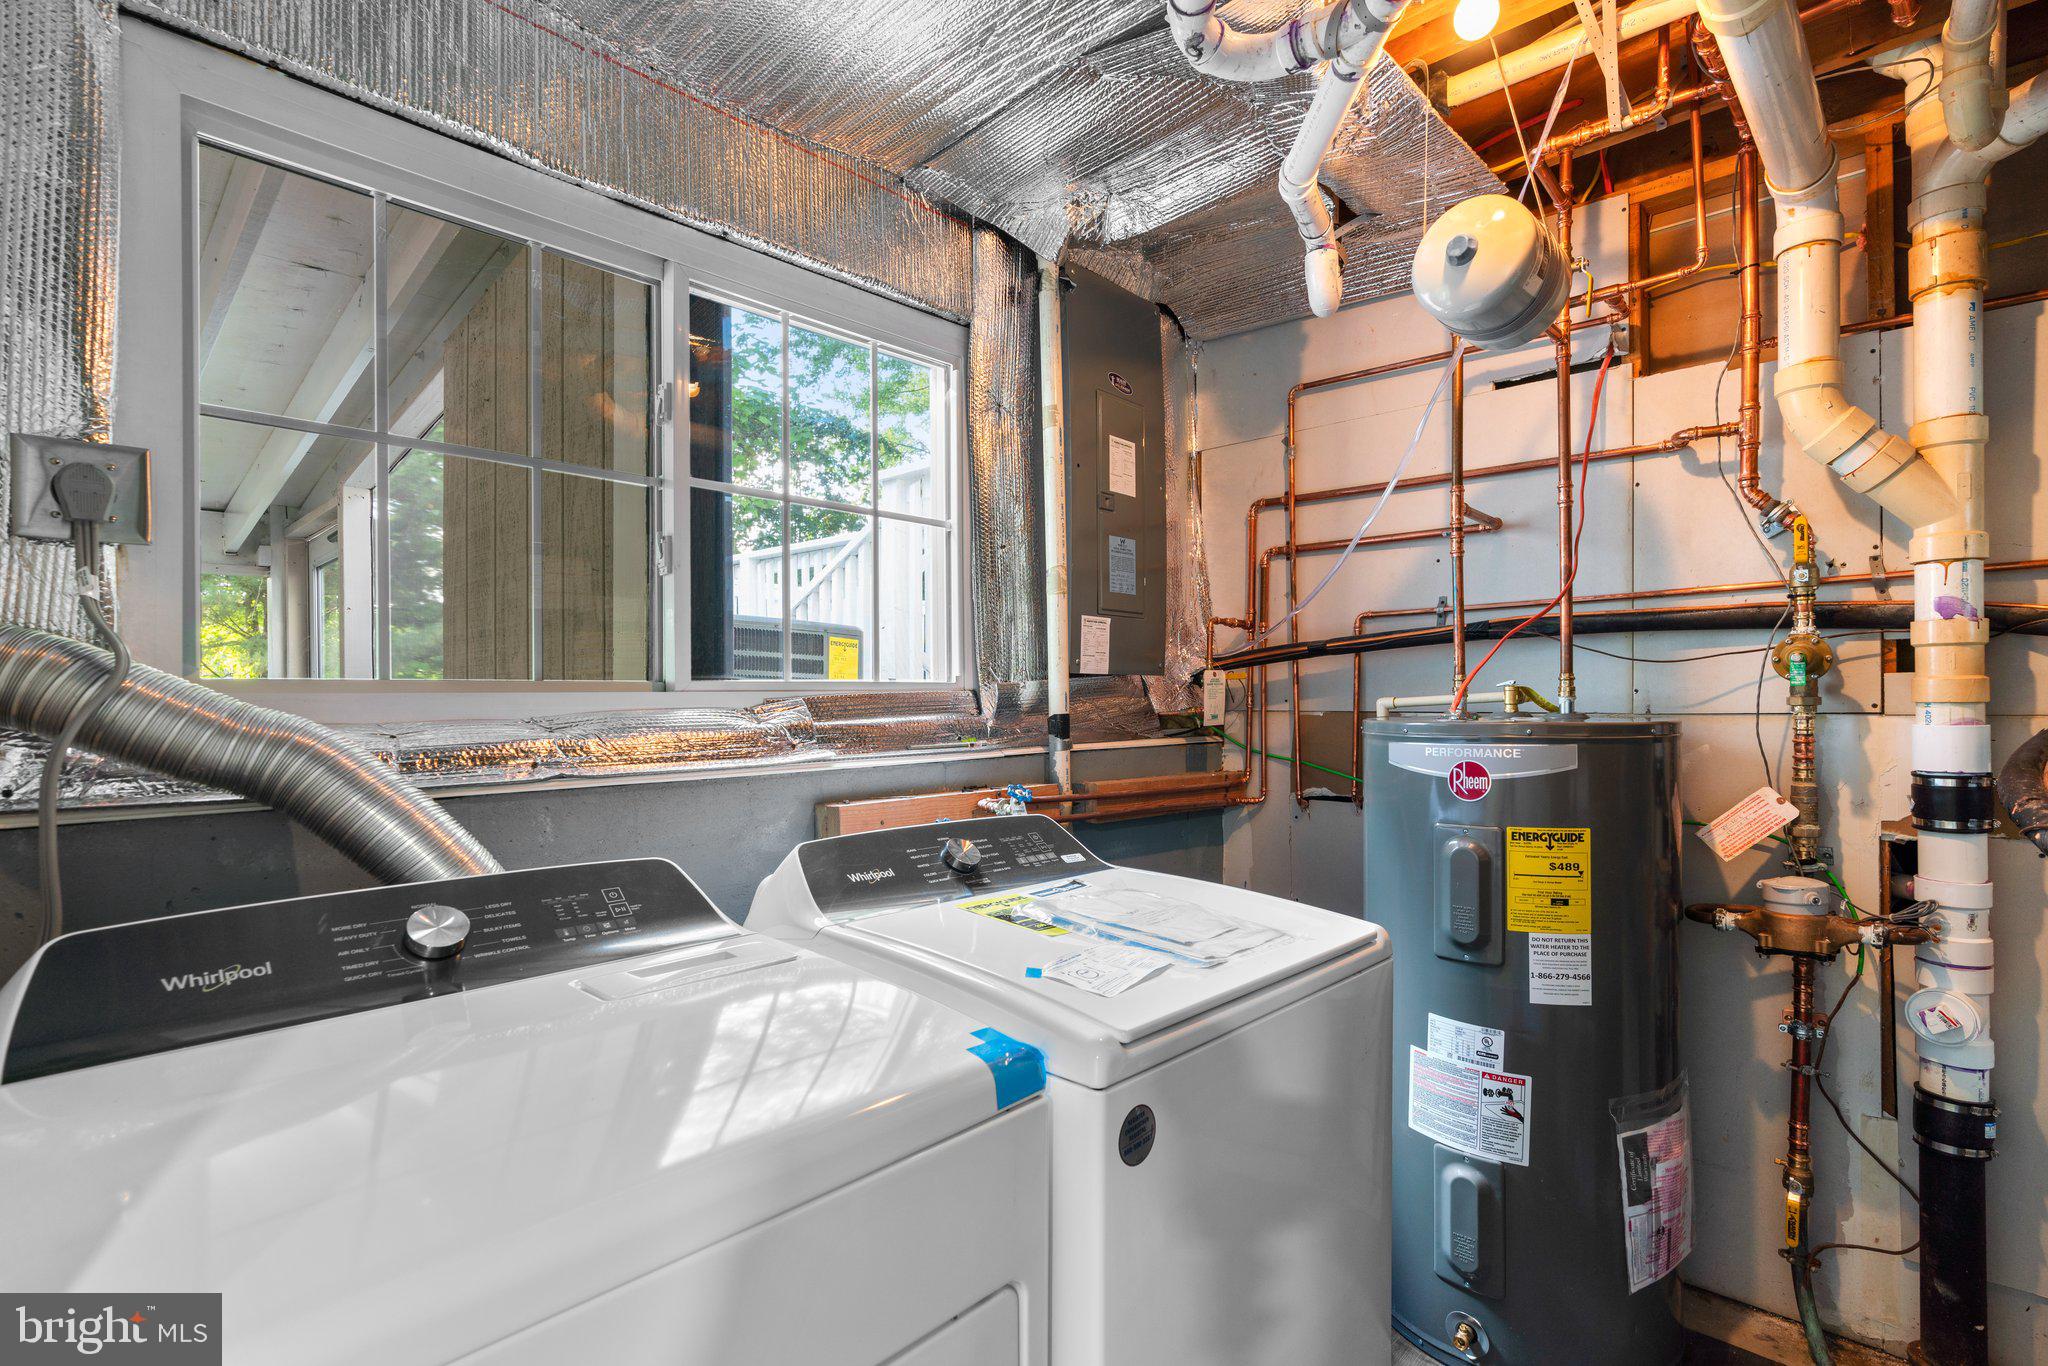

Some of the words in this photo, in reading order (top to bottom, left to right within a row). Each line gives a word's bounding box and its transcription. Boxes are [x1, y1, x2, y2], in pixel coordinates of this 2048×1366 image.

[1425, 747, 1522, 758] PERFORMANCE
[1452, 761, 1488, 795] Rheem
[1511, 831, 1585, 843] ENERGYGUIDE
[1549, 862, 1580, 871] $489
[847, 867, 896, 885] Whirlpool
[484, 910, 517, 919] DELICATES
[352, 922, 368, 930] DRY
[483, 925, 502, 933] BULKY
[502, 922, 522, 931] ITEMS
[333, 934, 357, 942] HEAVY
[358, 931, 378, 940] DUTY
[501, 935, 527, 943] TOWELS
[350, 947, 371, 955] ONLY
[474, 950, 501, 959] WRINKLE
[501, 945, 531, 954] CONTROL
[341, 963, 363, 971] TIMED
[363, 960, 380, 968] DRY
[161, 961, 273, 992] Whirlpool
[368, 971, 383, 979] DRY
[1491, 1074, 1524, 1085] DANGER
